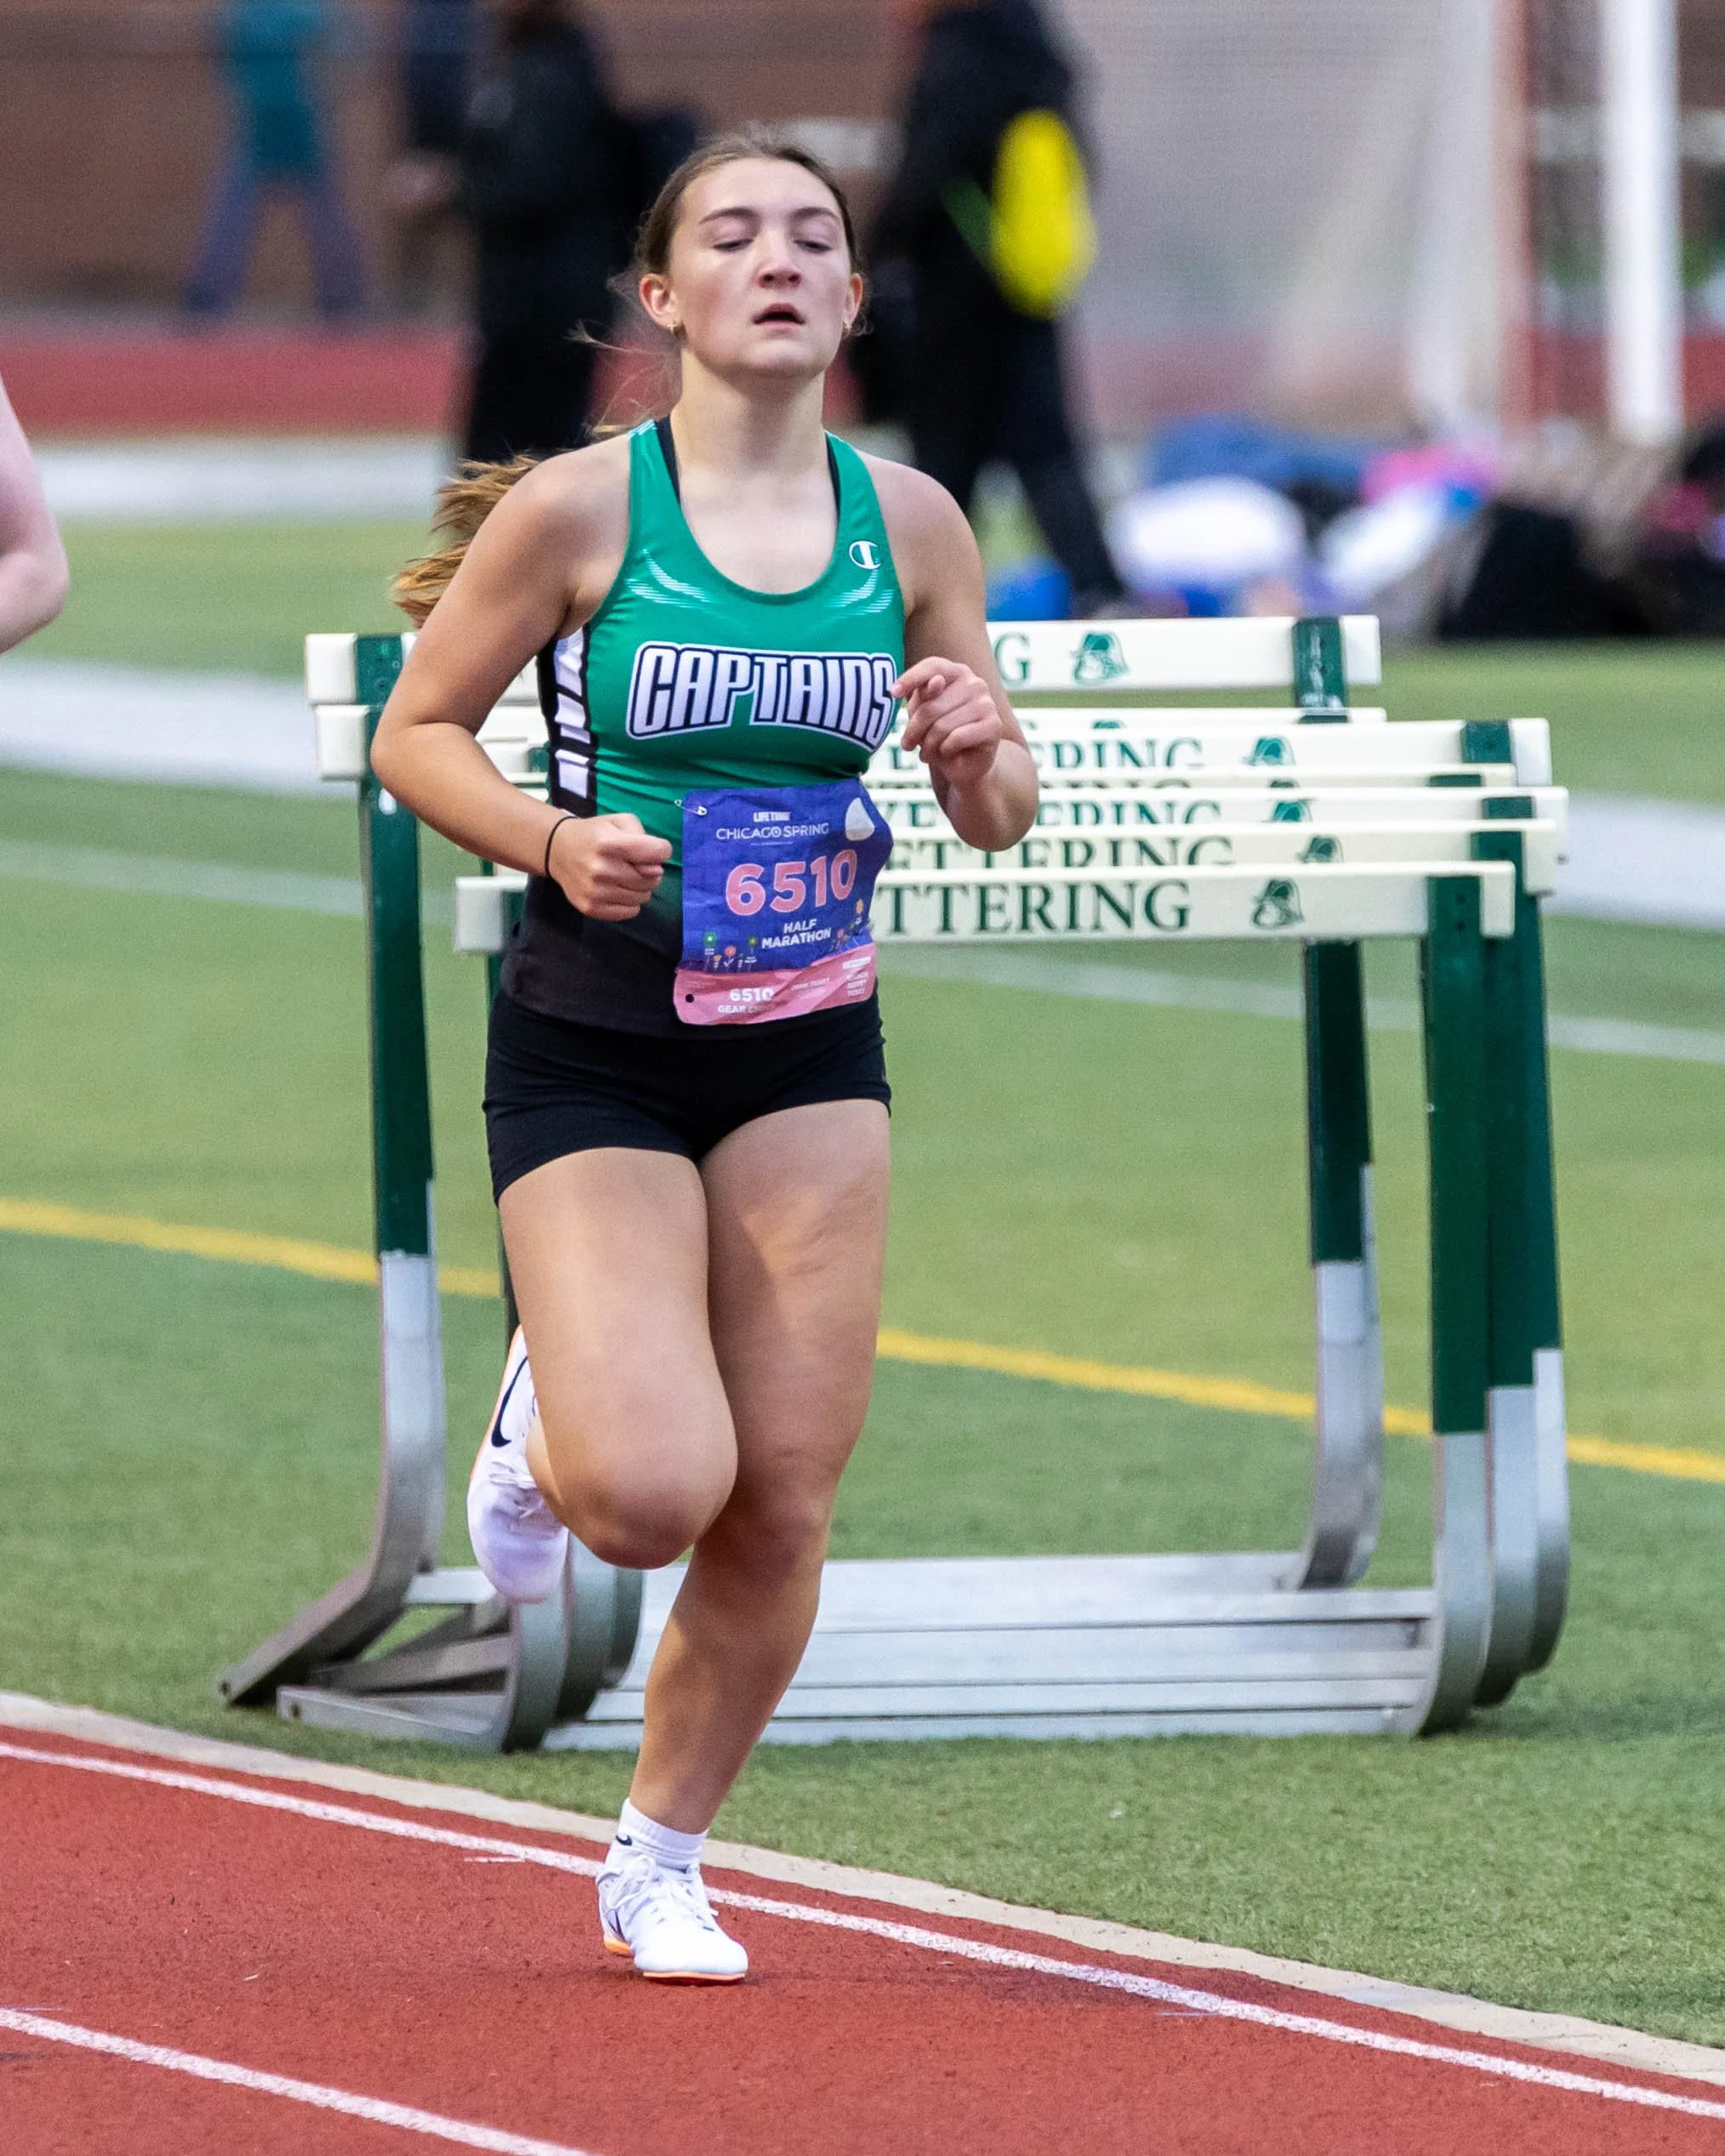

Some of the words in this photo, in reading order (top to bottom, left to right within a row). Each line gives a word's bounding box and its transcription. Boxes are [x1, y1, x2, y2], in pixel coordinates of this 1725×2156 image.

[626, 640, 897, 754] CAPTAINS
[716, 826, 782, 839] CHICAGO
[783, 822, 829, 838] SPRING
[726, 849, 857, 916] 6510
[873, 879, 1192, 934] TTERING
[783, 919, 817, 934] HALF
[761, 927, 831, 949] MARATHON
[730, 987, 774, 1002] 6510
[717, 1004, 746, 1014] GEAR
